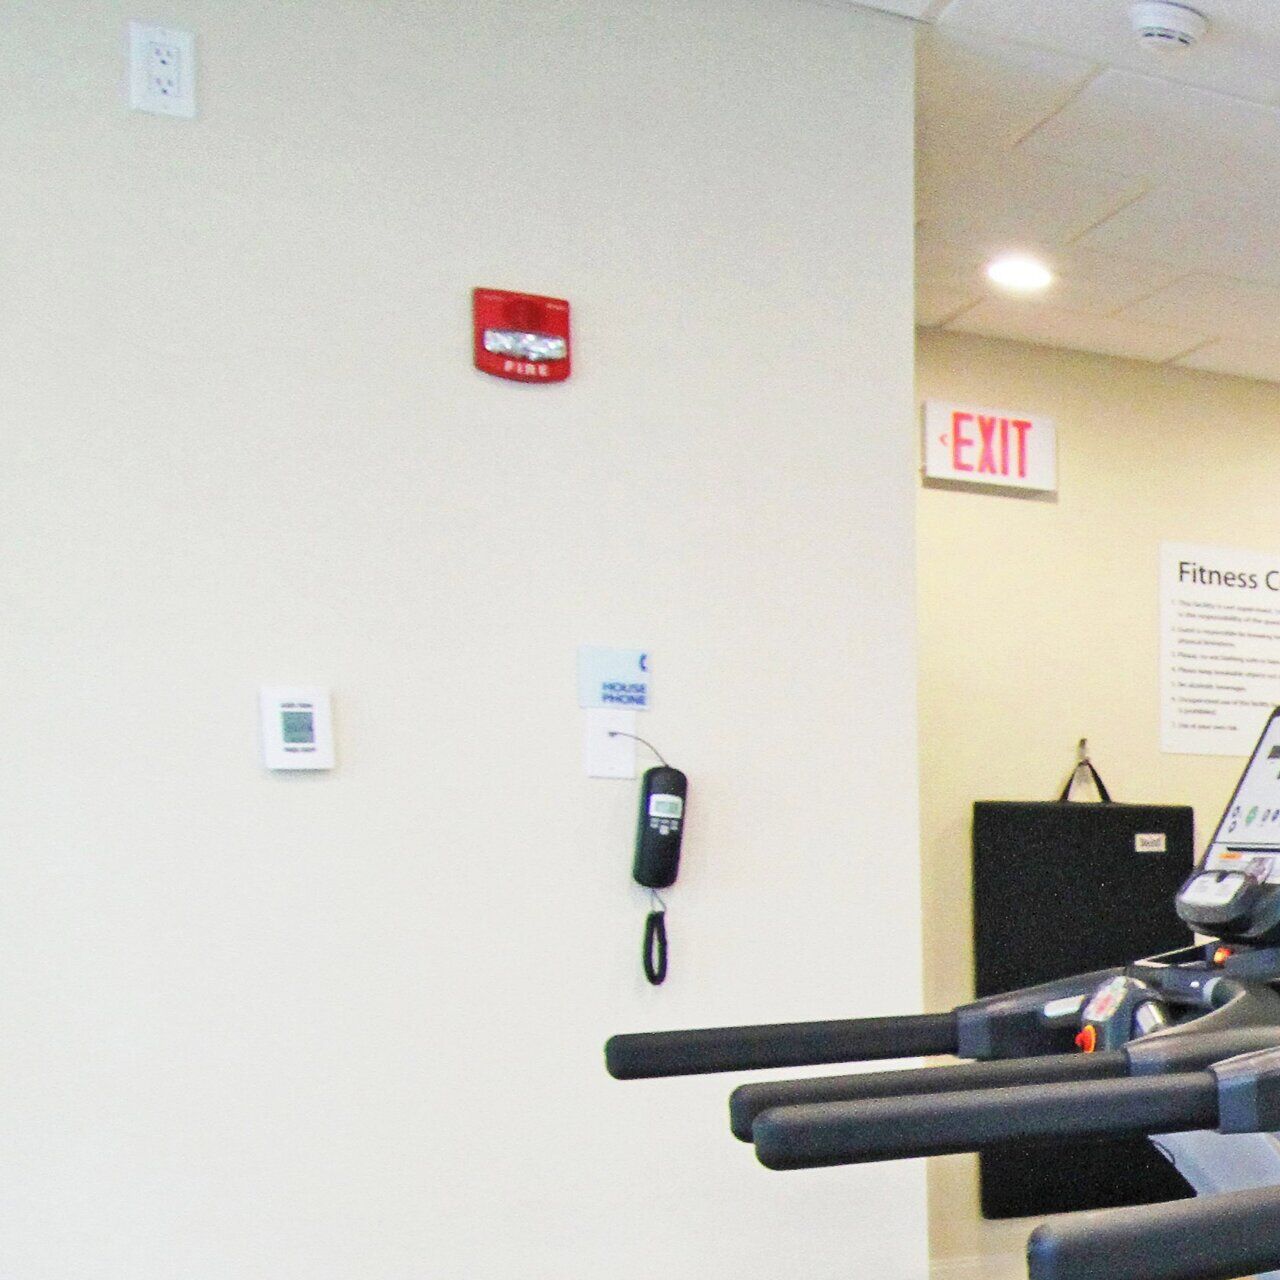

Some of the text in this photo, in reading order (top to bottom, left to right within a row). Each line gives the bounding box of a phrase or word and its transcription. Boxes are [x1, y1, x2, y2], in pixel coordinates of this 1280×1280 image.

[504, 361, 549, 376] FIRE
[952, 411, 1032, 478] EXIT
[1179, 562, 1258, 589] Fitness
[602, 682, 647, 694] HOUSE
[602, 694, 647, 705] PHONE
